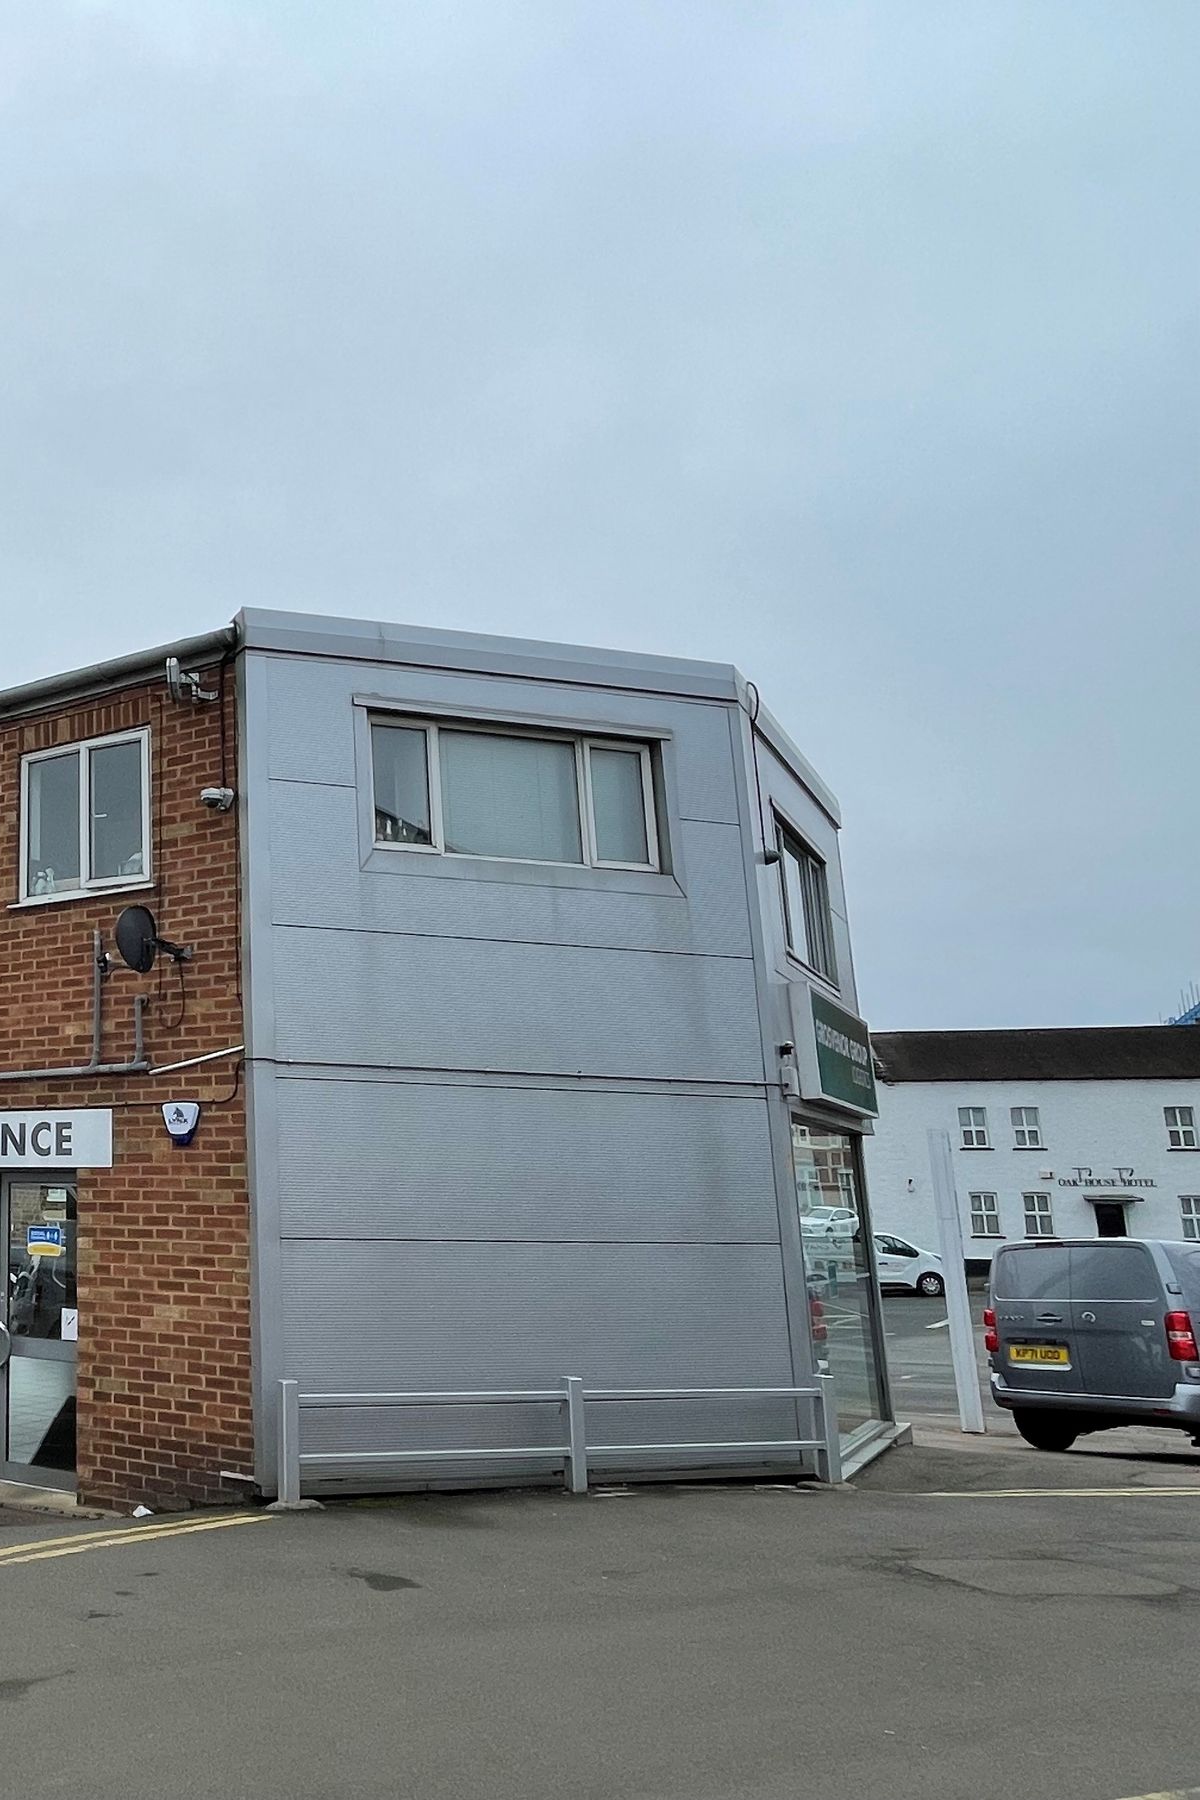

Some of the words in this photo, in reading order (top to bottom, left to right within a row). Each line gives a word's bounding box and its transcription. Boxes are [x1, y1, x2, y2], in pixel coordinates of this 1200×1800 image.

[1058, 1178, 1080, 1187] OAK
[1085, 1178, 1119, 1187] HOUSE
[1123, 1178, 1158, 1188] HOTEL
